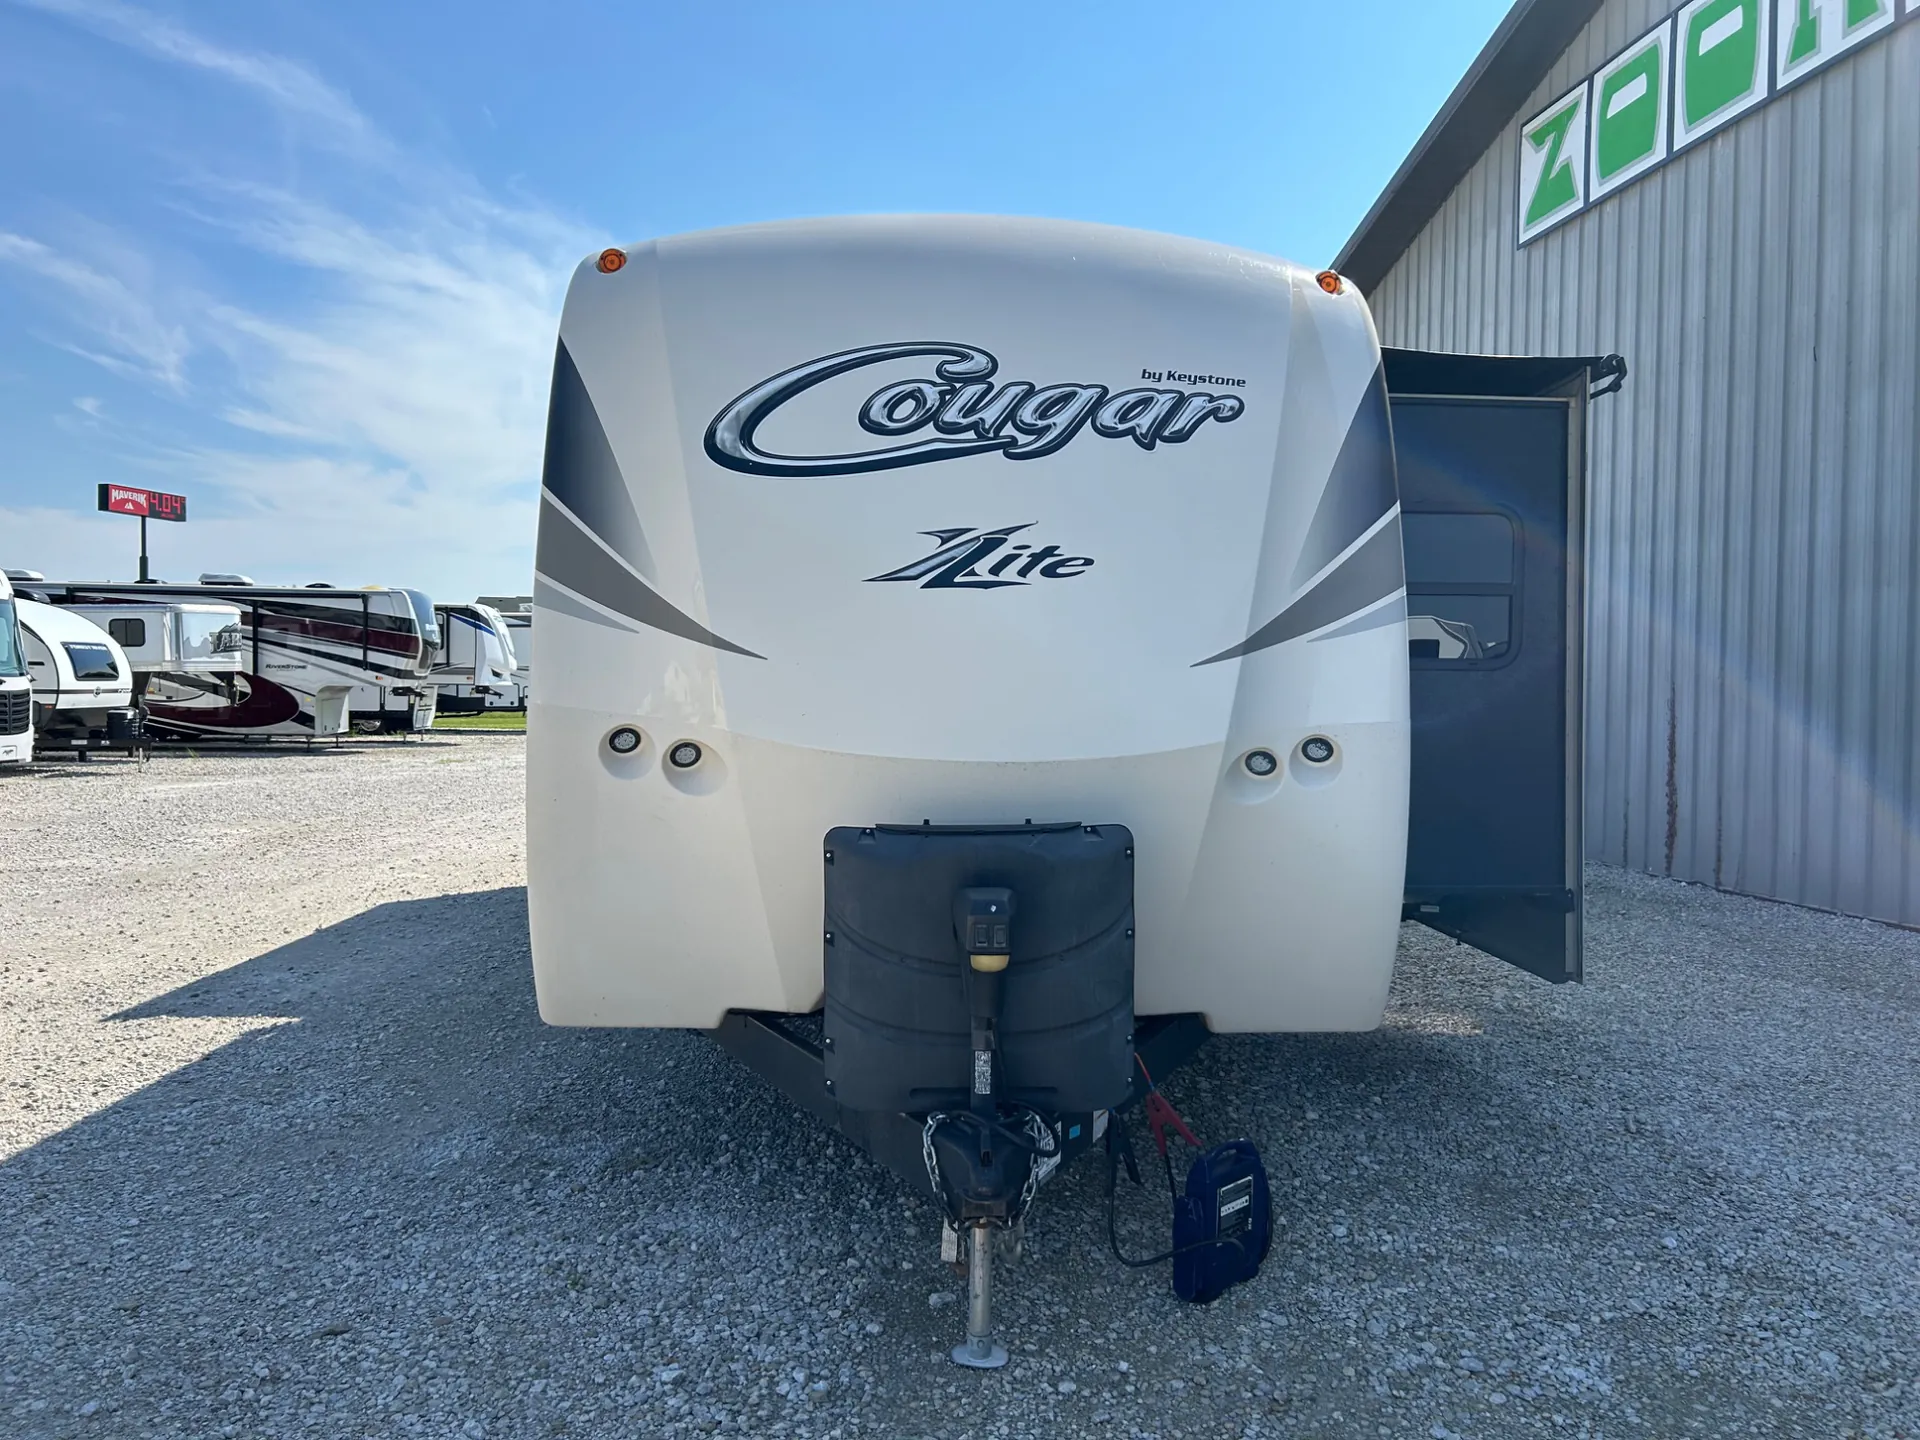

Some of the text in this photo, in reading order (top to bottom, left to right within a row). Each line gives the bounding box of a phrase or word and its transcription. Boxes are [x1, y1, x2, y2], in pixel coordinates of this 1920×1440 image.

[1141, 369, 1246, 387] by Keystone
[703, 341, 1245, 477] Cougar
[112, 489, 147, 508] MAVERIK
